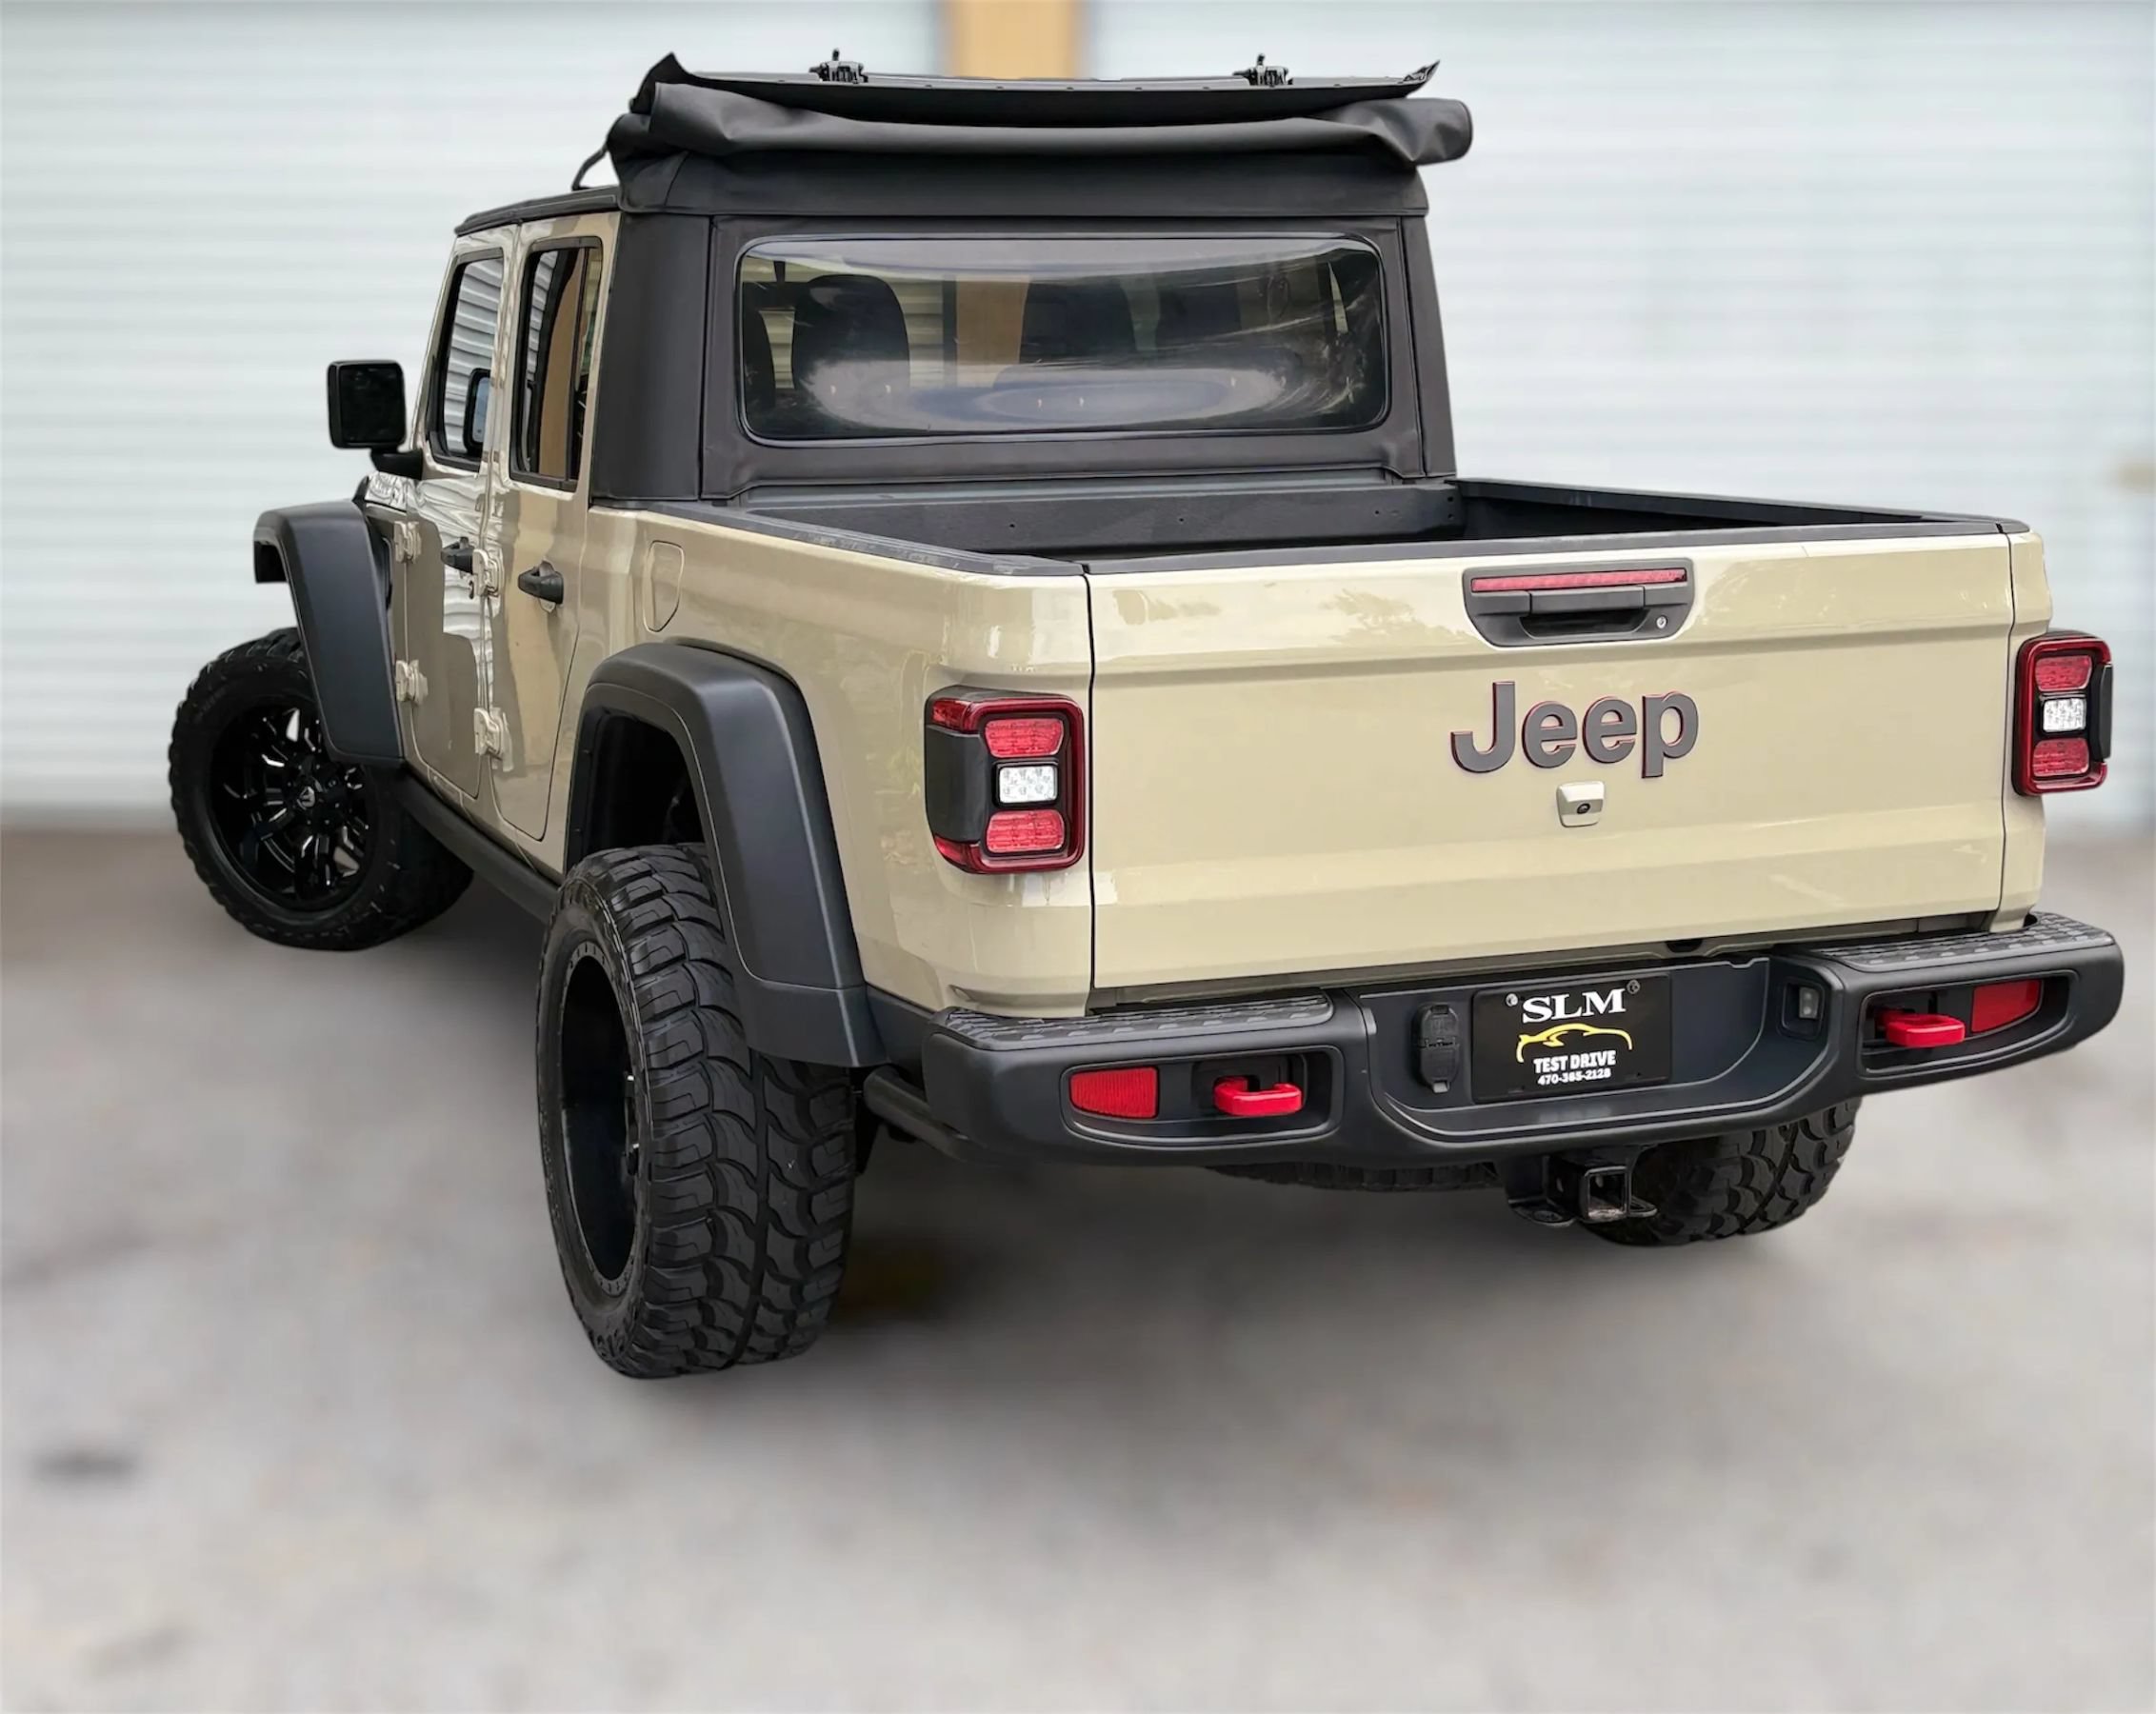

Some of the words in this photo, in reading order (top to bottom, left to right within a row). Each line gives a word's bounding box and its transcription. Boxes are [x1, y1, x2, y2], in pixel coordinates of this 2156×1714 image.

[1450, 680, 1699, 779] Jeep
[1522, 987, 1627, 1023] SLM
[1532, 1055, 1568, 1074] TEST
[1569, 1049, 1616, 1069] DRIVE
